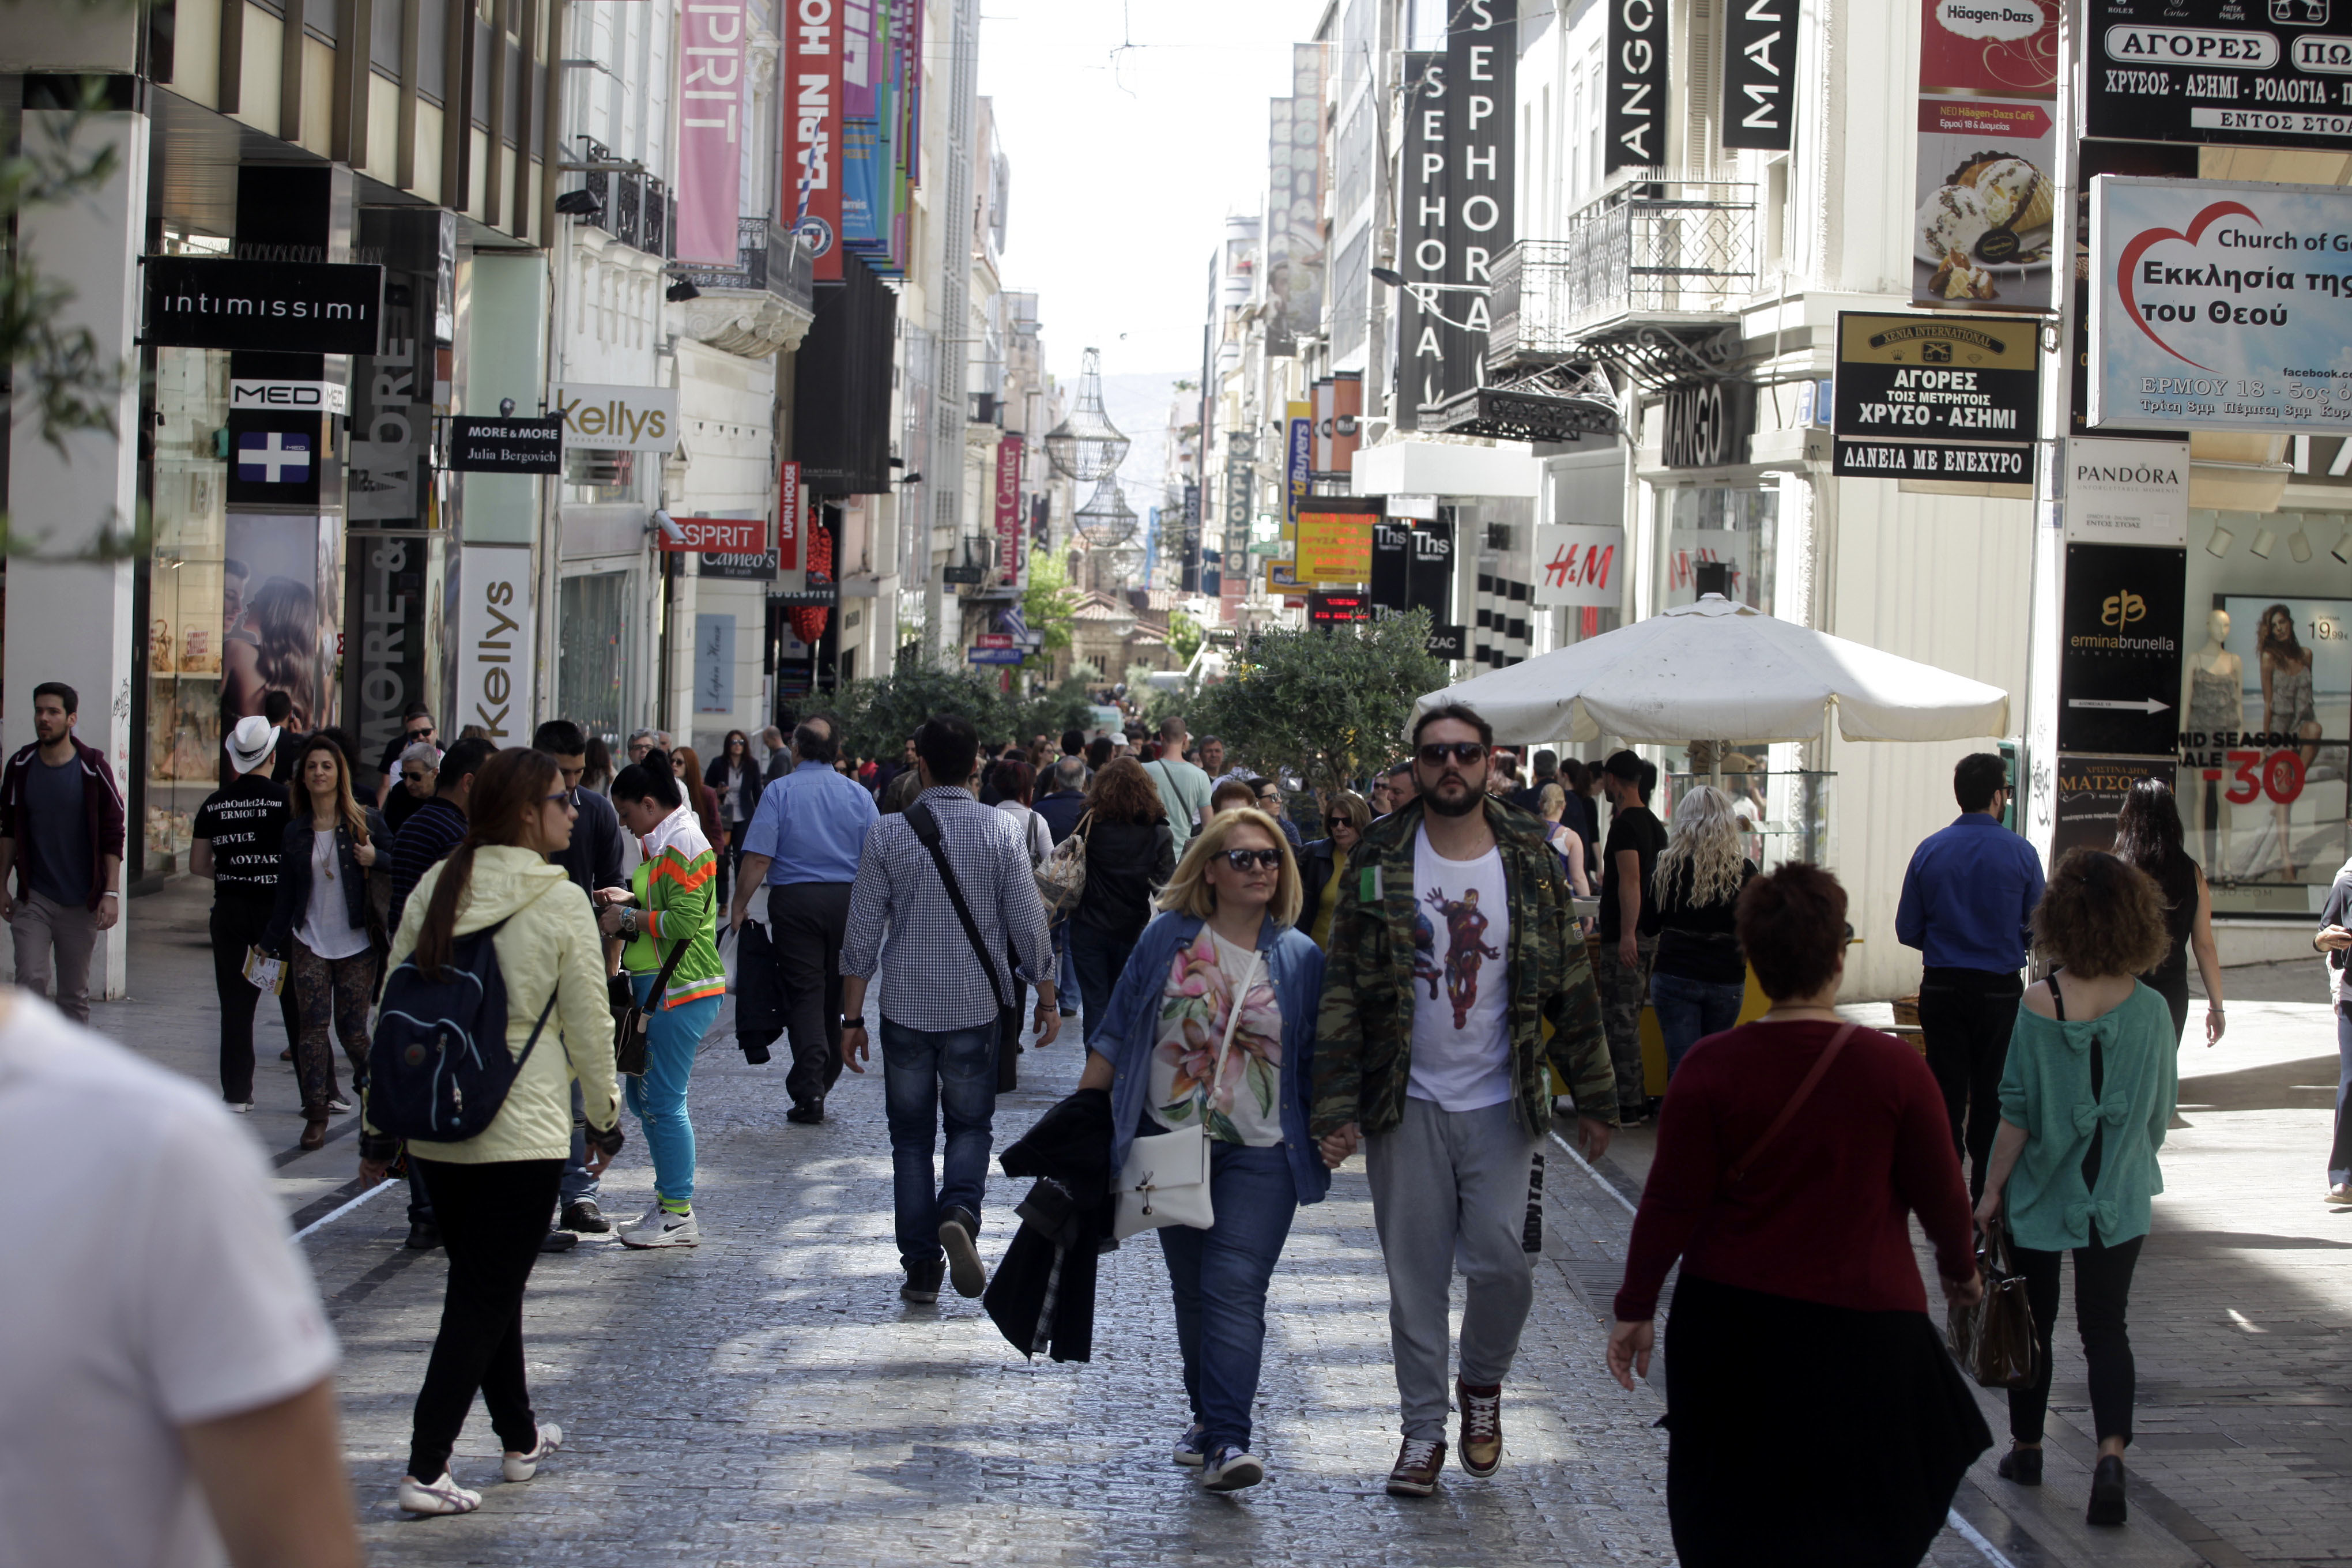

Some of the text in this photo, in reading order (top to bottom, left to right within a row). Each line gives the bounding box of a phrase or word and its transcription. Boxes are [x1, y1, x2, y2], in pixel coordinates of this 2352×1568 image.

[1947, 5, 2034, 23] Häagen-Dazs
[2163, 7, 2189, 17] Cartier
[2219, 12, 2245, 21] PHILIPPE
[2223, 5, 2242, 13] PATEK
[2121, 33, 2261, 61] ΑΓΟΡΕΣ
[2105, 69, 2169, 96] ΧΡΥΣΟΣ
[2185, 74, 2239, 99] ΑΣΗΜΙ
[2255, 77, 2326, 104] ΡΟΛΟΓΙΑ
[1958, 108, 2014, 119] Häagen-Dazs
[2015, 111, 2035, 120] Café
[2220, 112, 2293, 130] ΕΝΤΟΣ
[797, 74, 829, 190] LAPIN
[1940, 119, 2010, 131] Ερμού 18 & Διομείας
[1463, 0, 1497, 331] SEPHORA
[1416, 67, 1446, 359] SEPHORA
[2218, 229, 2352, 252] Church of G
[2143, 261, 2352, 298] Εκκλησία της
[2141, 300, 2288, 327] του Θεού
[1883, 326, 1991, 347] XENIA INTERNATIONAL
[1894, 369, 1977, 390] ΑΓΟΡΕΣ
[235, 385, 321, 405] MED
[327, 388, 344, 407] MED
[1886, 390, 1991, 406] ΤΟΙΣ ΜΕΤΡΗΤΟΙΣ
[2140, 376, 2228, 396] ΕΡΜΟΥ
[2237, 380, 2265, 397] 18
[2289, 382, 2330, 405] 5ος
[558, 389, 666, 444] Kellys
[1859, 403, 1931, 425] ΧΡΥΣΟ
[1948, 407, 2016, 429] ΑΣΗΜΙ
[2140, 399, 2181, 413] Τρίτη
[2187, 401, 2215, 414] 8μμ
[2223, 402, 2278, 418] Πέμπτη
[2283, 405, 2312, 419] 8μμ
[468, 427, 507, 438] MORE
[519, 427, 558, 440] MORE
[1662, 383, 1722, 466] MANGO
[468, 448, 557, 463] Julia Bergovich
[1844, 447, 2022, 474] ΔΑΝΕΙΑ ΜΕ ΕΝΕΧΥΡΟ
[997, 447, 1016, 509] Center
[1291, 423, 1310, 522] ldBuyers
[2078, 465, 2178, 484] PANDORA
[783, 465, 796, 538] LAPIN HOUSE
[1374, 525, 1407, 545] Ths
[1411, 531, 1449, 555] Ths
[702, 552, 776, 568] Cameo's
[1417, 553, 1443, 561] fashion
[1544, 544, 1614, 590] H&M
[2071, 634, 2174, 651] erminabrunella
[477, 581, 519, 737] Kellys
[2213, 732, 2300, 748] SEASON
[206, 798, 282, 813] WatchOutlet24.com
[221, 809, 267, 820] ERMOU 18
[212, 832, 256, 846] SERVICE
